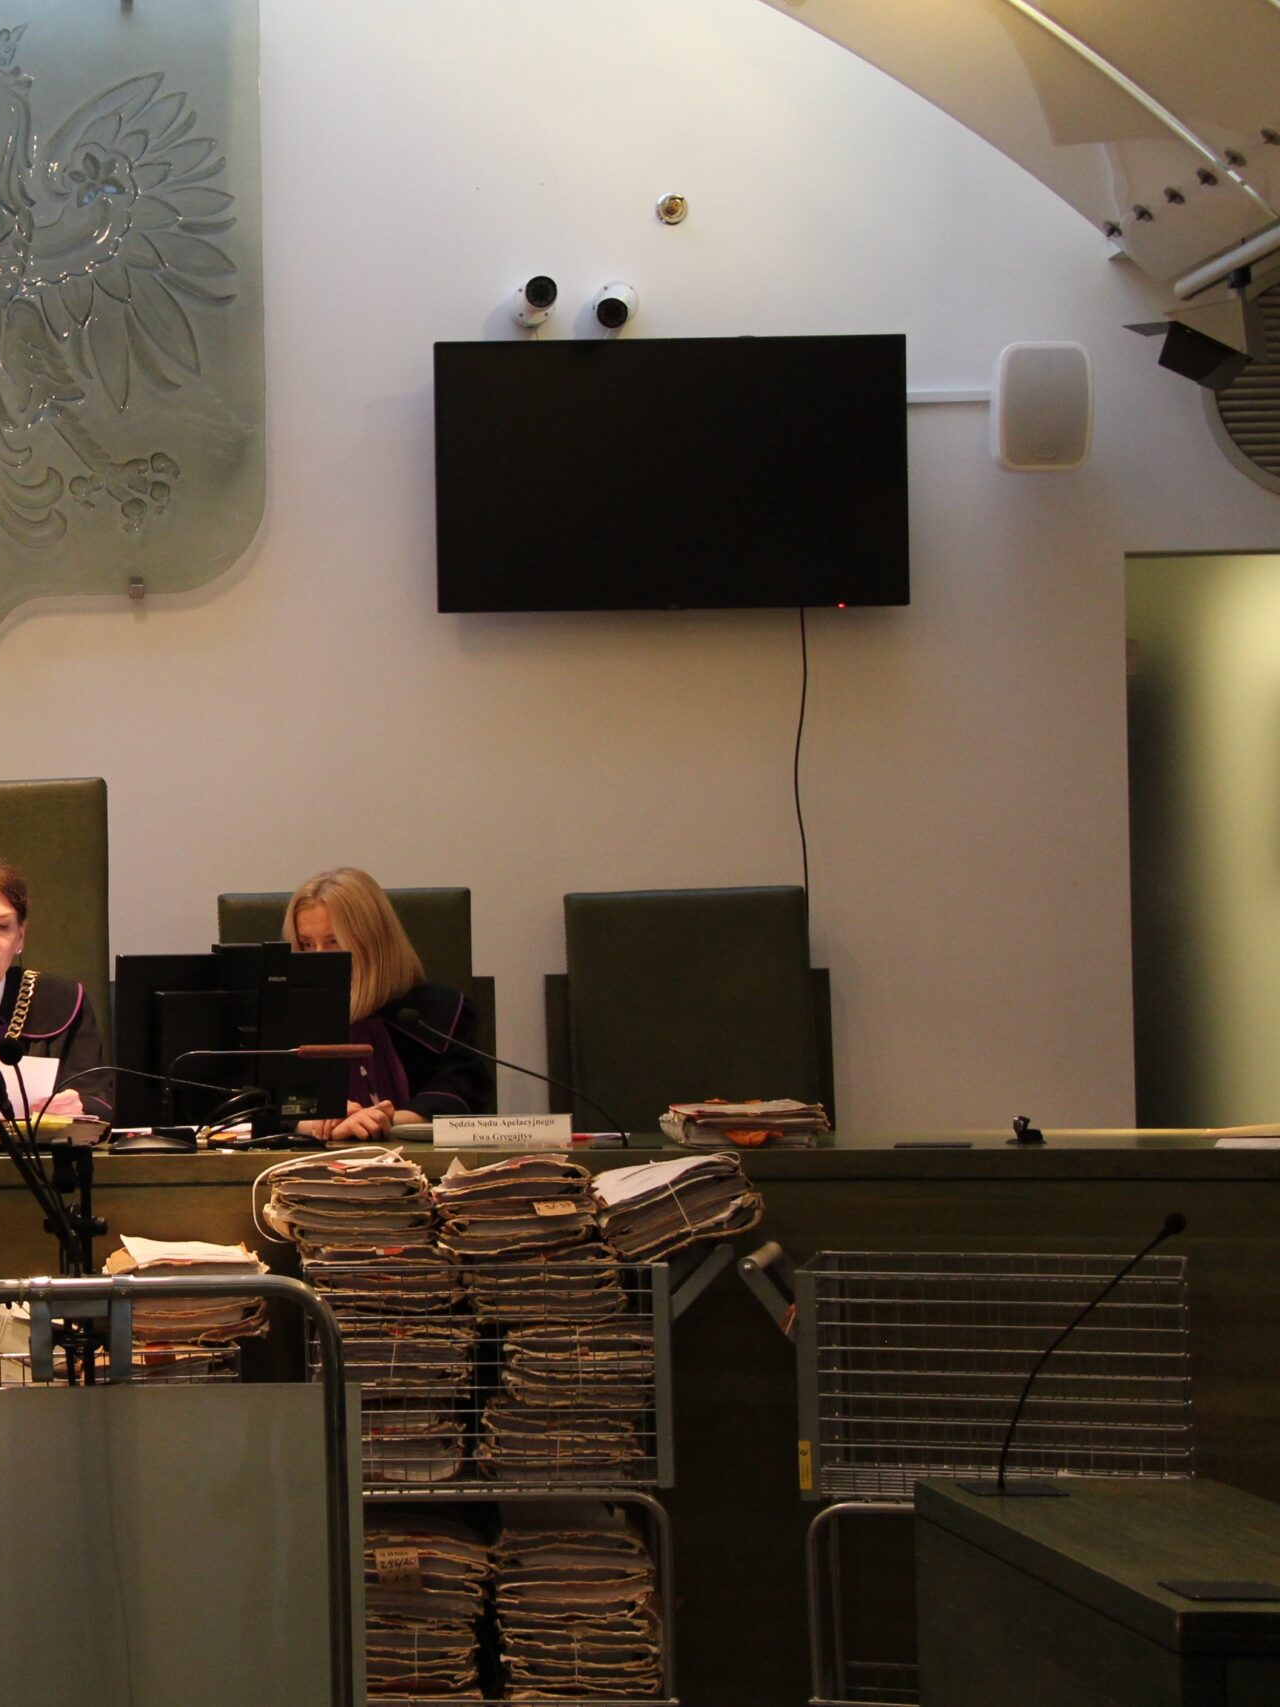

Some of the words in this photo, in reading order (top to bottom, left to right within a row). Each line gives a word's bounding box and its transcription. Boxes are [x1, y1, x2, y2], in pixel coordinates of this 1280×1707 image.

[449, 1120, 475, 1130] Sędzia
[477, 1119, 498, 1128] Sądu
[500, 1118, 555, 1128] Apelacyjnego
